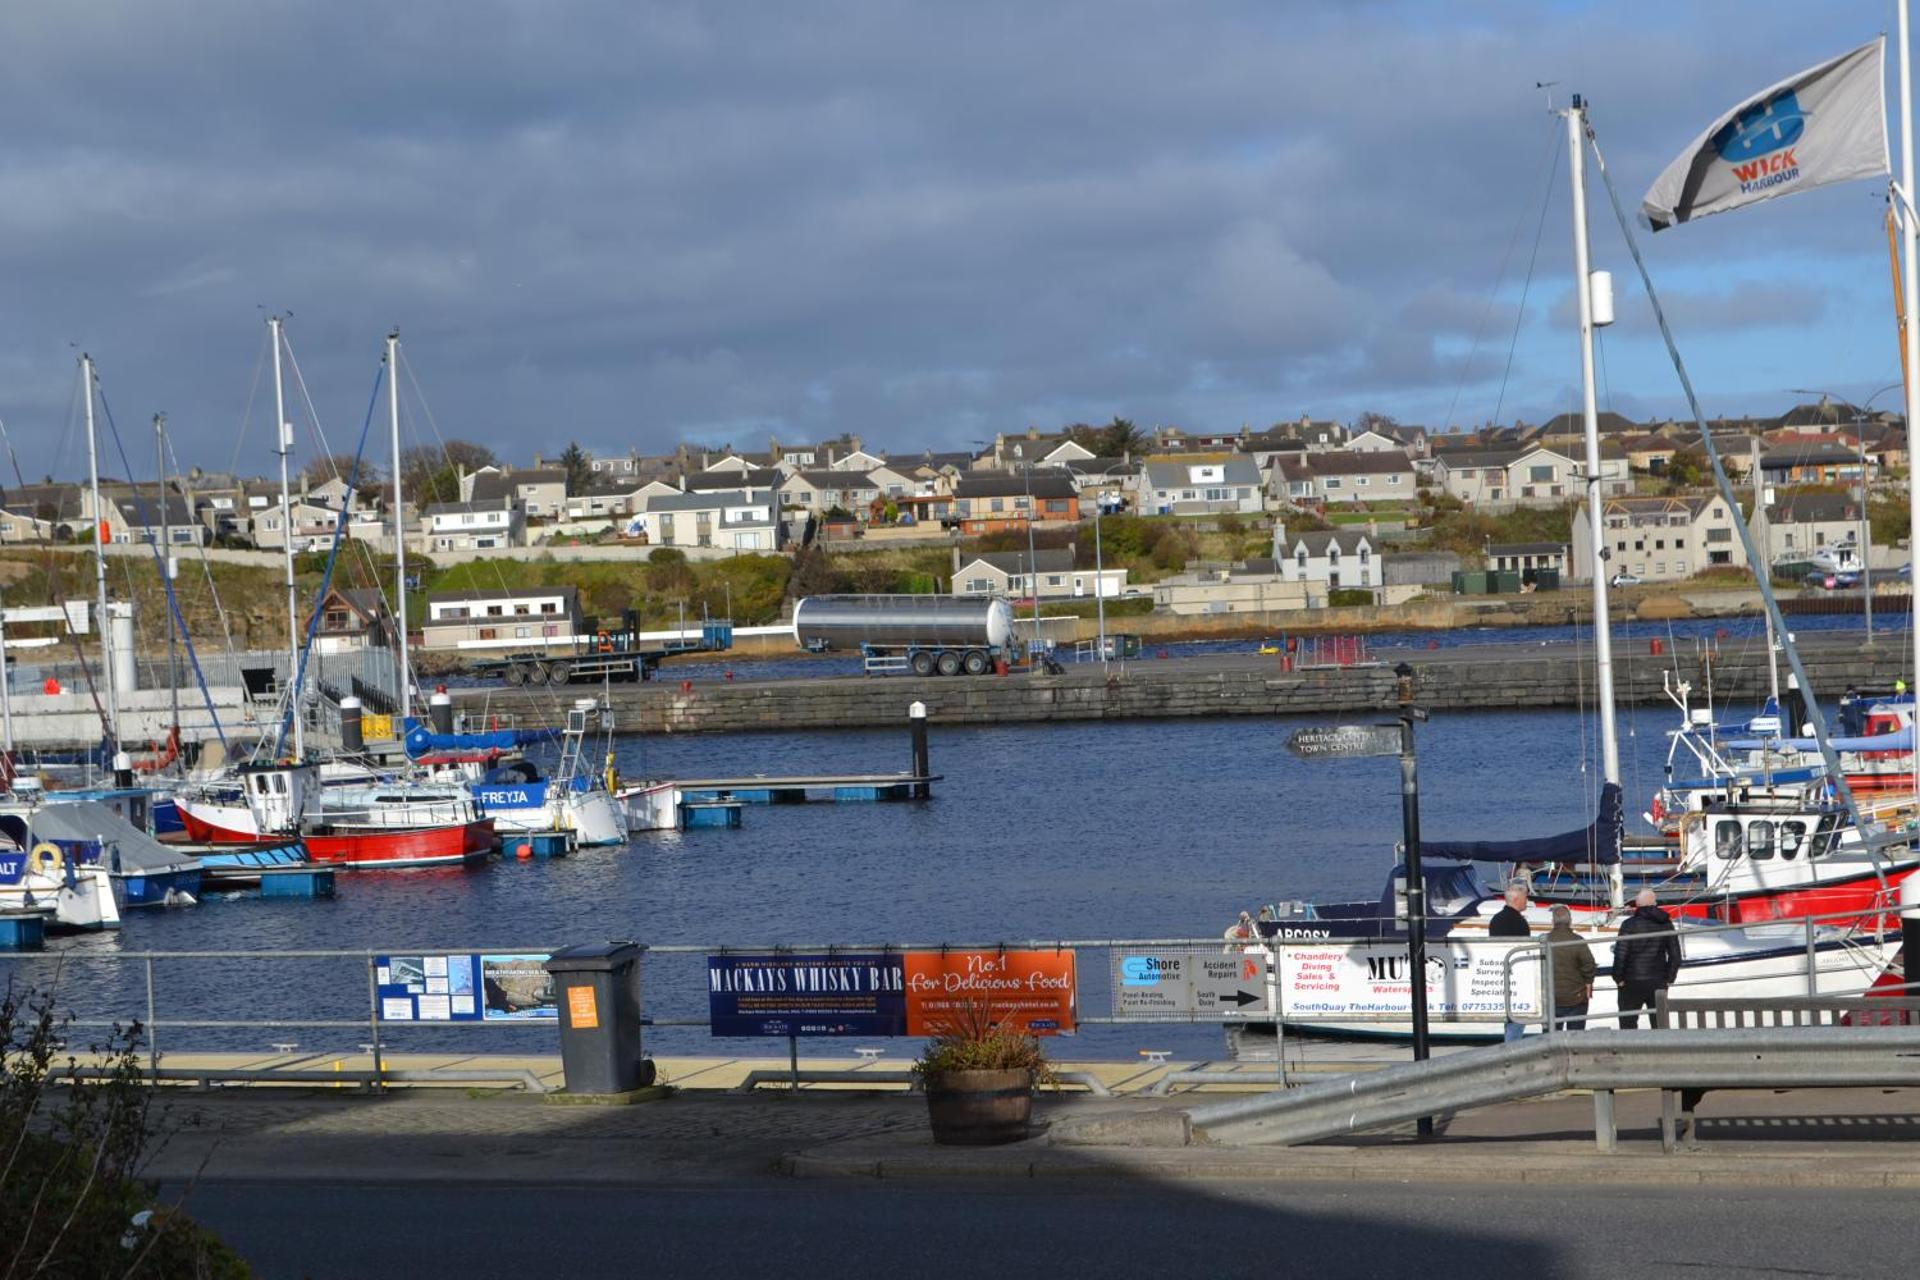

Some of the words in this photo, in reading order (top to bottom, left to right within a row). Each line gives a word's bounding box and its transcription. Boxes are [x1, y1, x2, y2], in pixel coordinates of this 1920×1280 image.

[1732, 148, 1798, 184] WICK
[1740, 169, 1800, 194] HARBOUR
[1299, 743, 1327, 753] TOWN
[482, 790, 528, 804] FREYJA
[1294, 952, 1343, 962] Chandlery
[967, 955, 1006, 973] No.1
[1146, 958, 1180, 970] Shore
[1203, 961, 1237, 969] Accident
[1302, 962, 1332, 972] Diving
[1138, 972, 1181, 980] Automotive
[1208, 970, 1237, 979] Repairs
[1296, 972, 1323, 980] Sales
[1328, 972, 1335, 980] &
[1476, 968, 1504, 976] Survey
[710, 968, 786, 992] MACKAYS
[794, 967, 861, 992] WHISKY
[870, 967, 904, 991] BAR
[944, 972, 1022, 993] Delicious
[1294, 982, 1340, 992] Servicing
[1293, 1003, 1346, 1012] SouthQuay
[1349, 1003, 1407, 1011] TheHarbour
[1462, 1003, 1531, 1011] 0775335143
